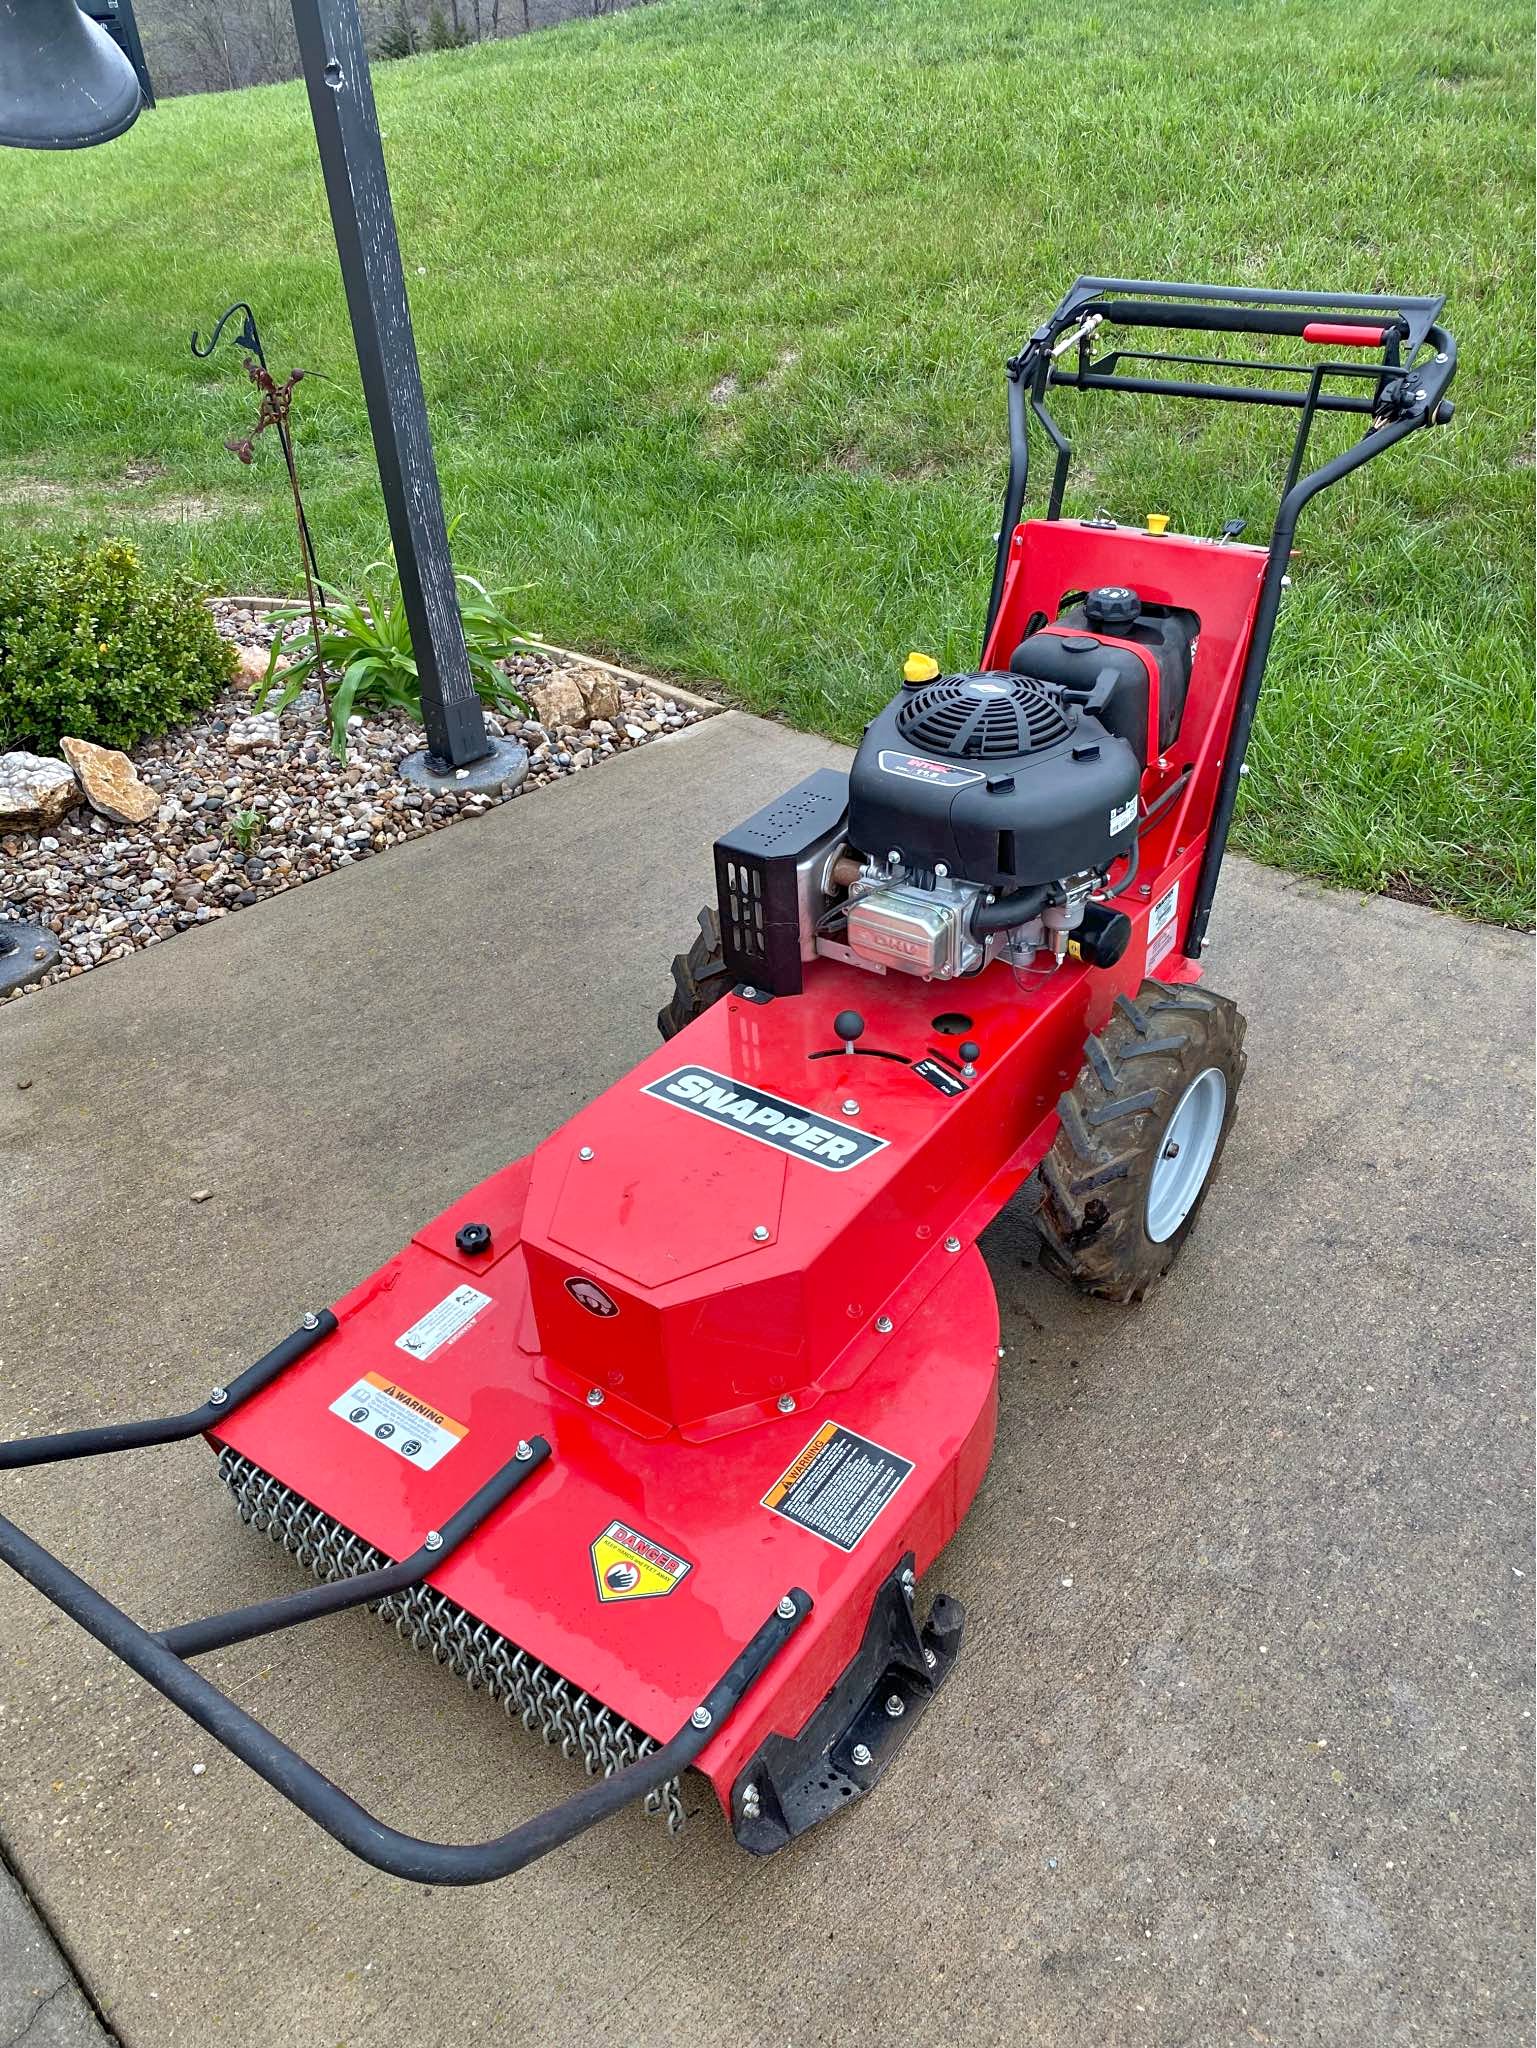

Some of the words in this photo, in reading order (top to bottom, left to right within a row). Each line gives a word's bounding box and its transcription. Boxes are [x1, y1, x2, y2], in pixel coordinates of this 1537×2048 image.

[665, 1074, 859, 1163] SNAPPER
[395, 1391, 445, 1425] WARNING
[789, 1440, 825, 1481] WARNING
[612, 1528, 680, 1574] DANGER
